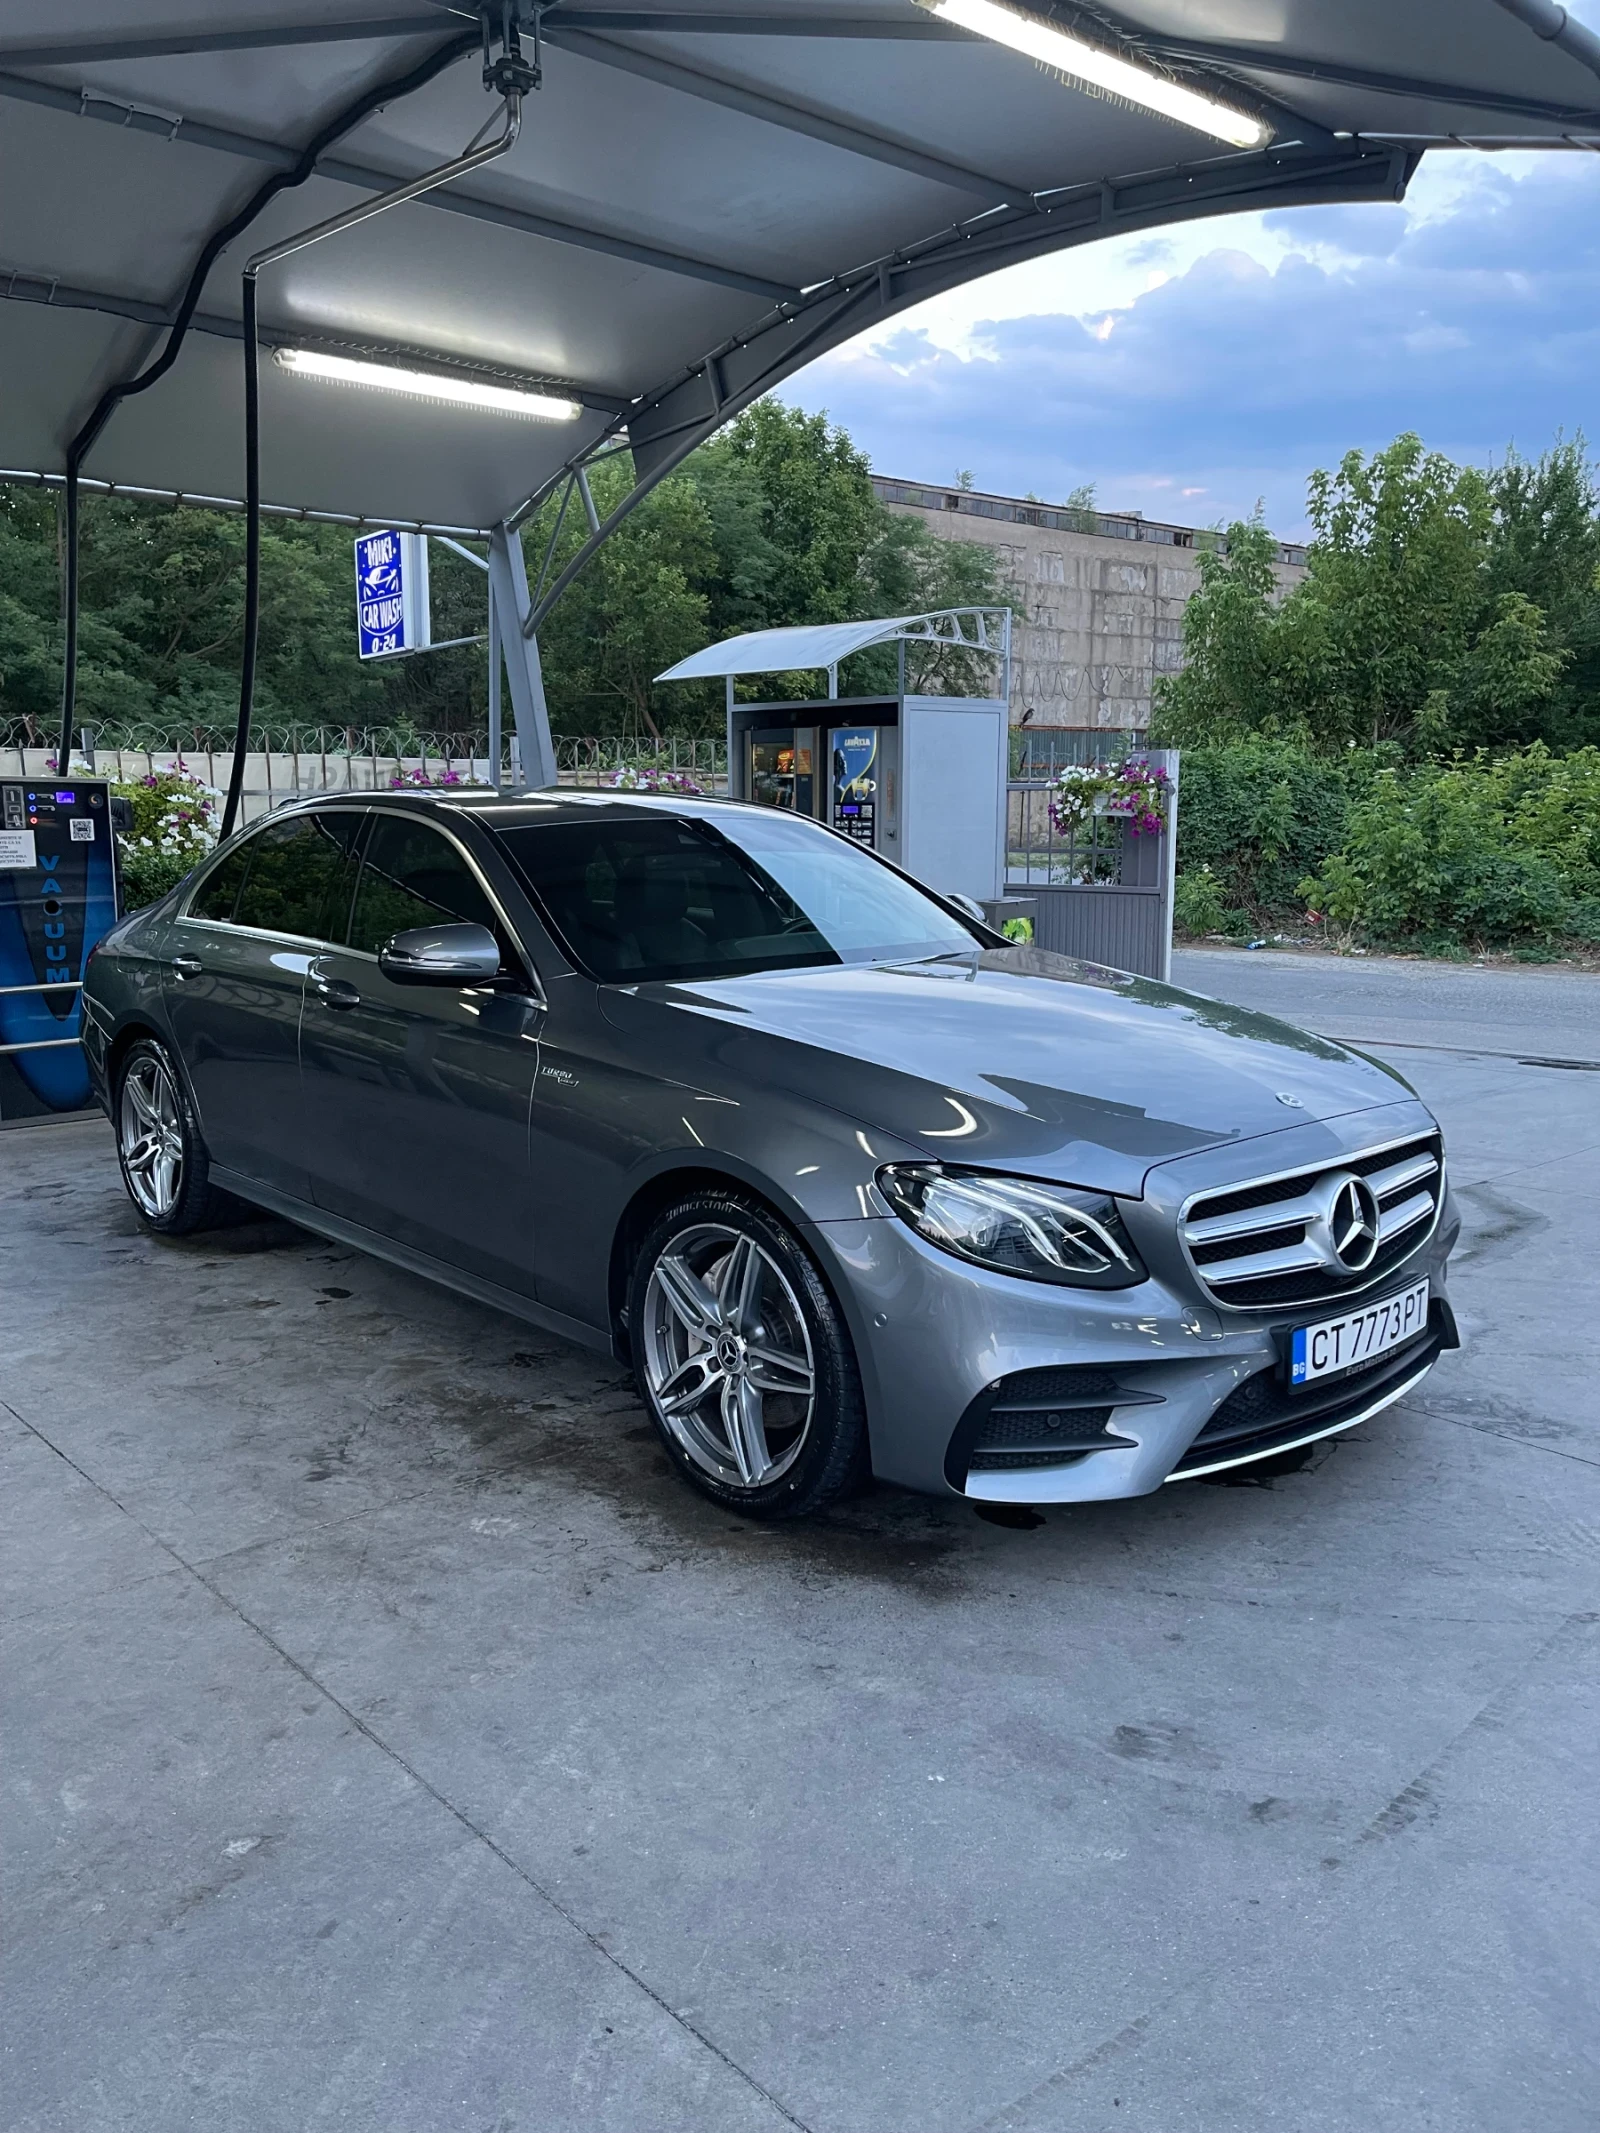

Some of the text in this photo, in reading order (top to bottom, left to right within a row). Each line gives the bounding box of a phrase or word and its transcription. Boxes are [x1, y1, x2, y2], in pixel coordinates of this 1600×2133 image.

[363, 596, 402, 629] CAR WASH
[1350, 1302, 1401, 1359] 7773
[1292, 1362, 1306, 1377] BG
